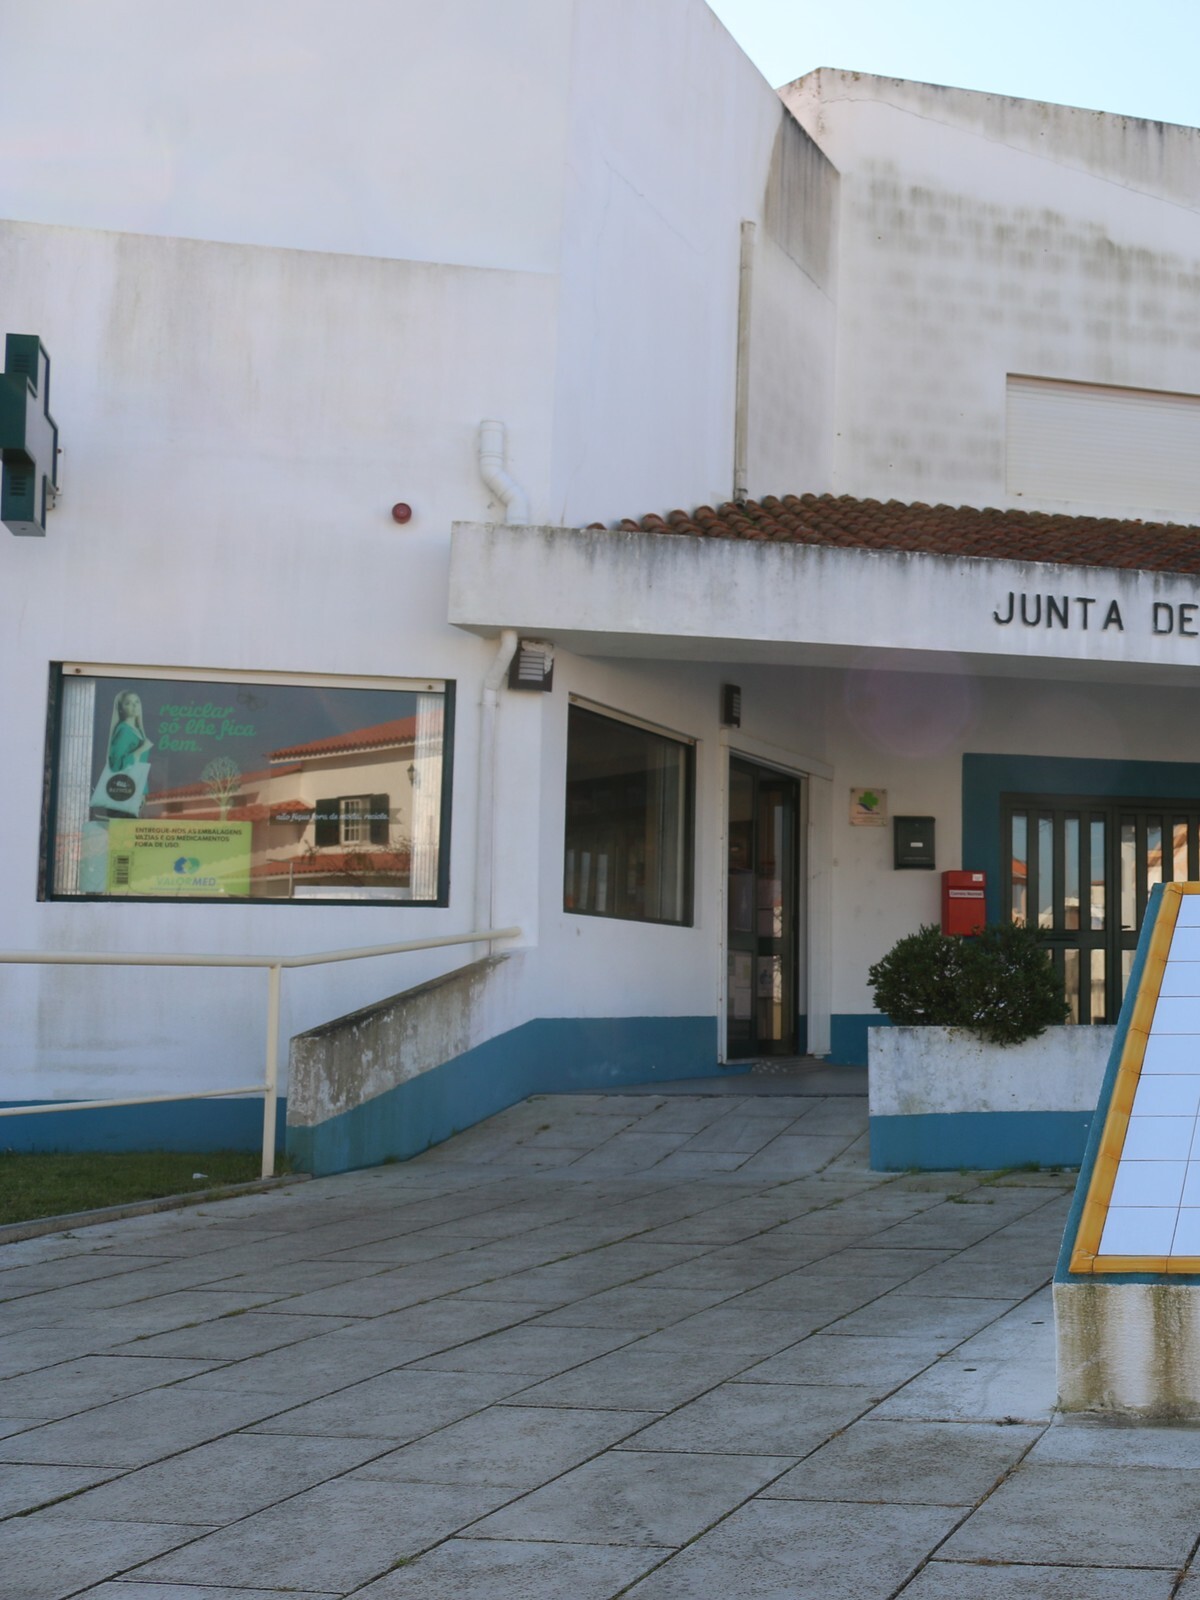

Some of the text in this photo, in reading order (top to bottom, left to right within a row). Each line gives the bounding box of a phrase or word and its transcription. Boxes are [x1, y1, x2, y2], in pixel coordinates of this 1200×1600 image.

[993, 592, 1124, 631] JUNTA
[1152, 602, 1199, 636] DE
[160, 702, 234, 718] reciclar
[159, 717, 257, 741] só lhe fica
[159, 734, 202, 752] bem.
